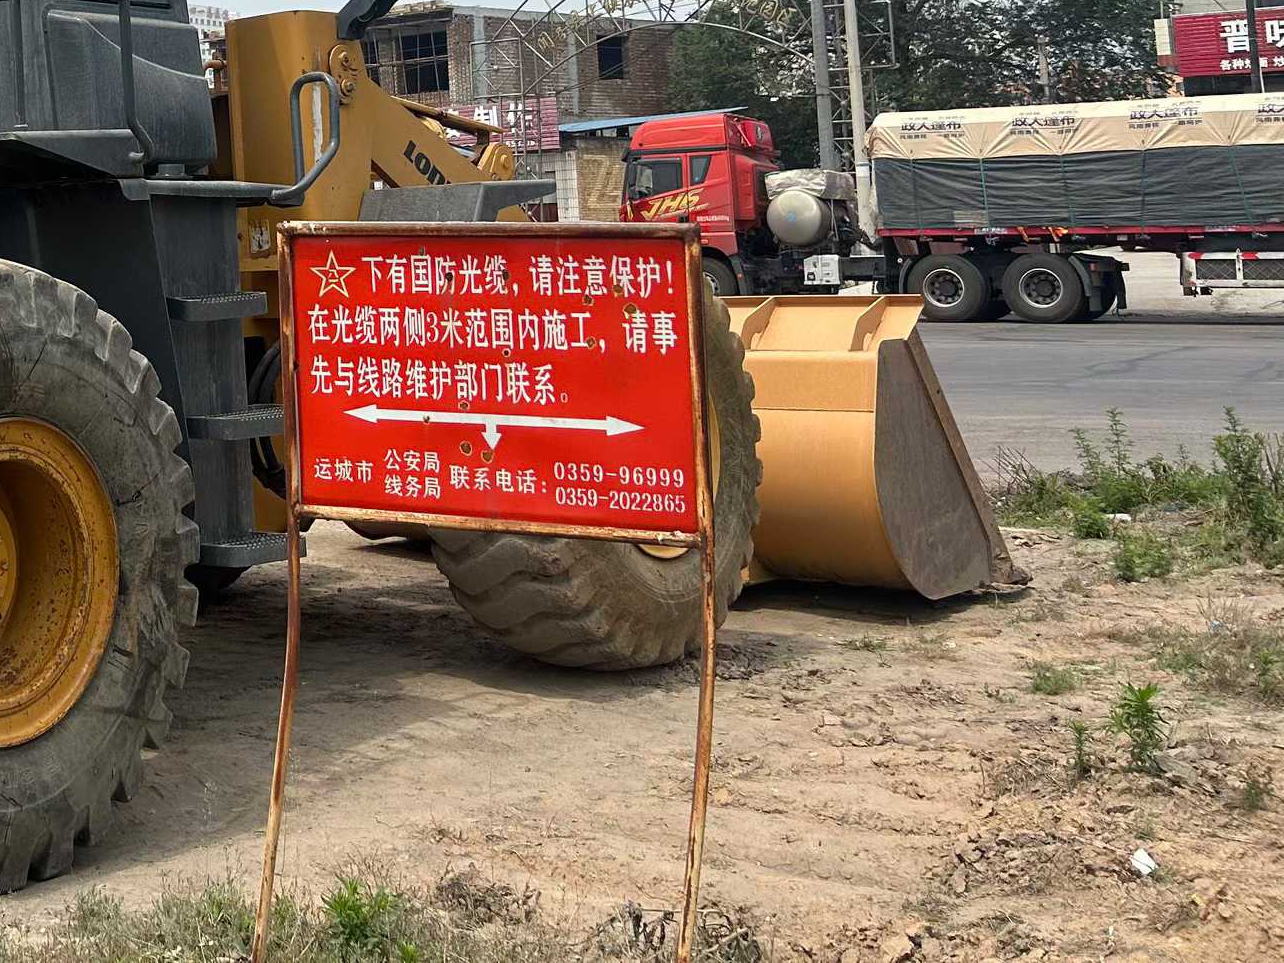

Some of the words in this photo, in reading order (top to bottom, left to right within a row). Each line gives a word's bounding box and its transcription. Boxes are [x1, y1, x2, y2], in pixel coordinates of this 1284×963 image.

[403, 140, 451, 185] LON
[310, 355, 569, 406] 先与线路维护部门联系。
[314, 457, 374, 484] 运城市
[384, 448, 441, 474] 公安局
[554, 461, 684, 488] 0359-96999
[384, 474, 442, 500] 线务局
[555, 486, 686, 513] 0359-2022865
